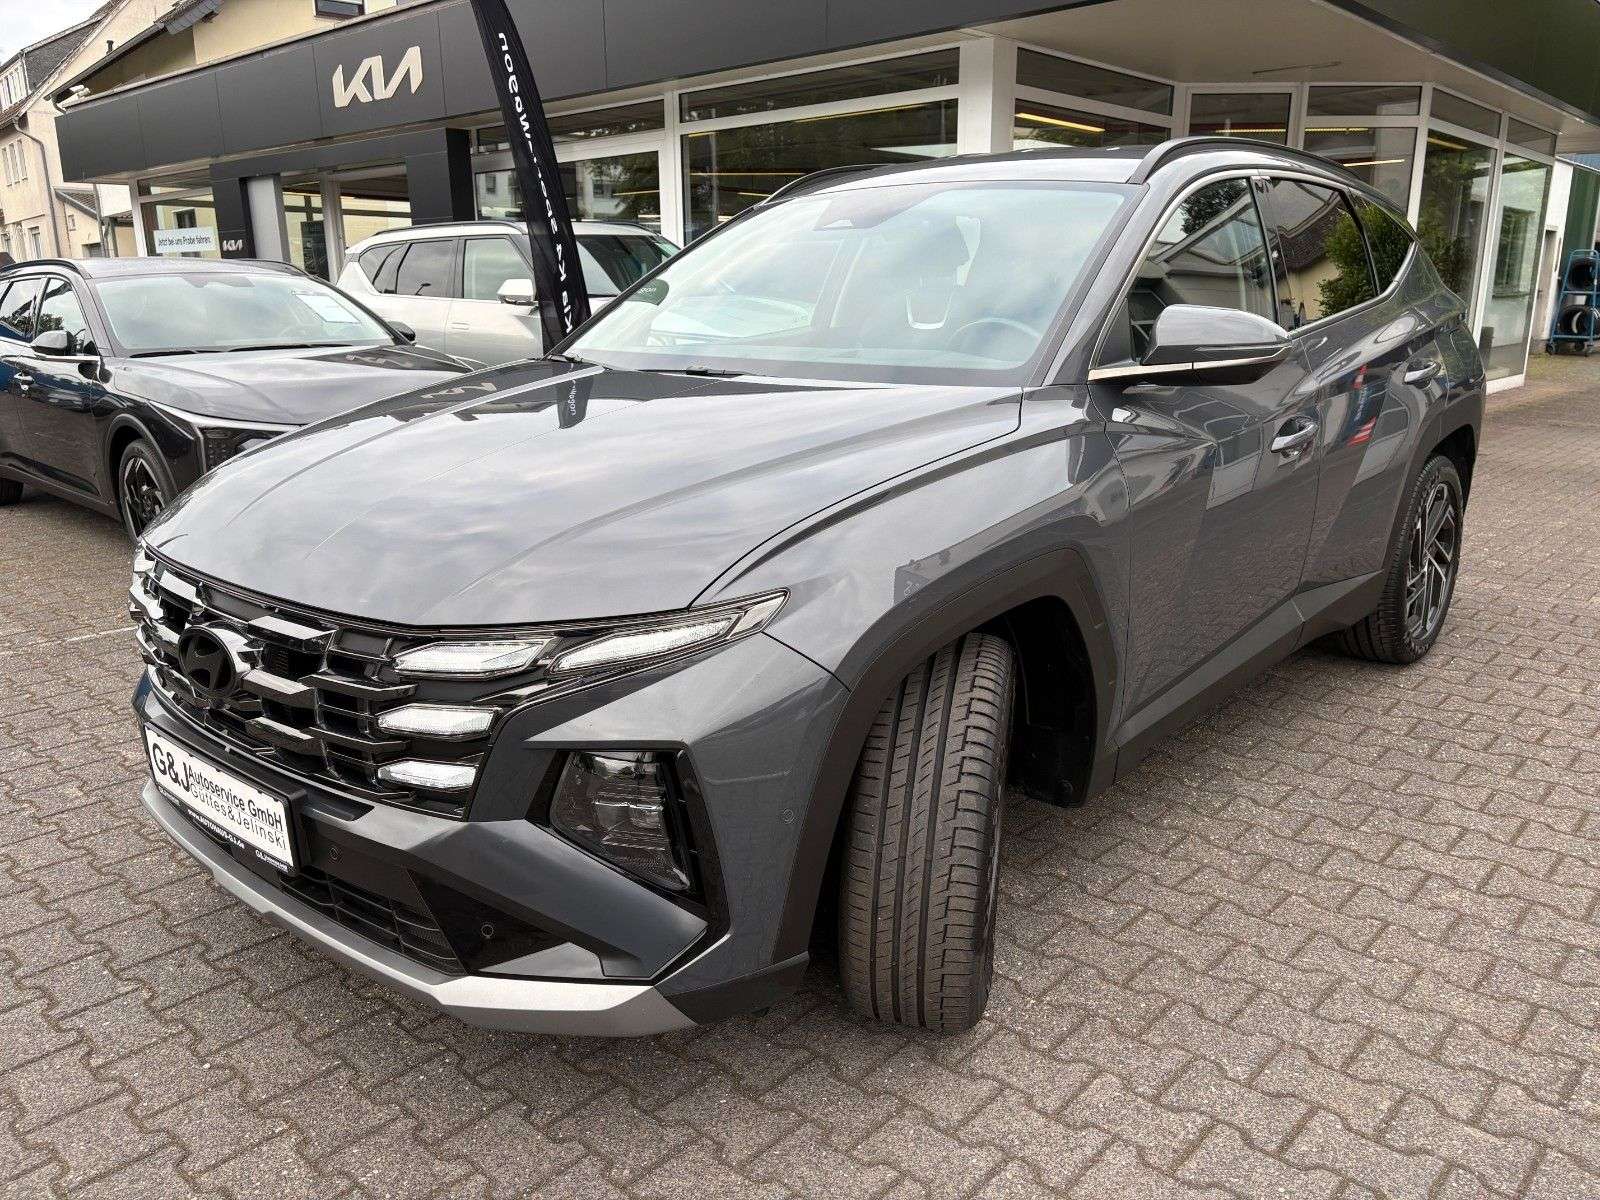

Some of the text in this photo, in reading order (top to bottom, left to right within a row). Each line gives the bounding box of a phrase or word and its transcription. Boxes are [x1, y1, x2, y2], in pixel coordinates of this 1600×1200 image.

[332, 45, 423, 108] KIA
[222, 239, 243, 251] KIA
[152, 742, 190, 792] G&J
[188, 765, 246, 811] Autoservice
[247, 799, 283, 832] GmbH
